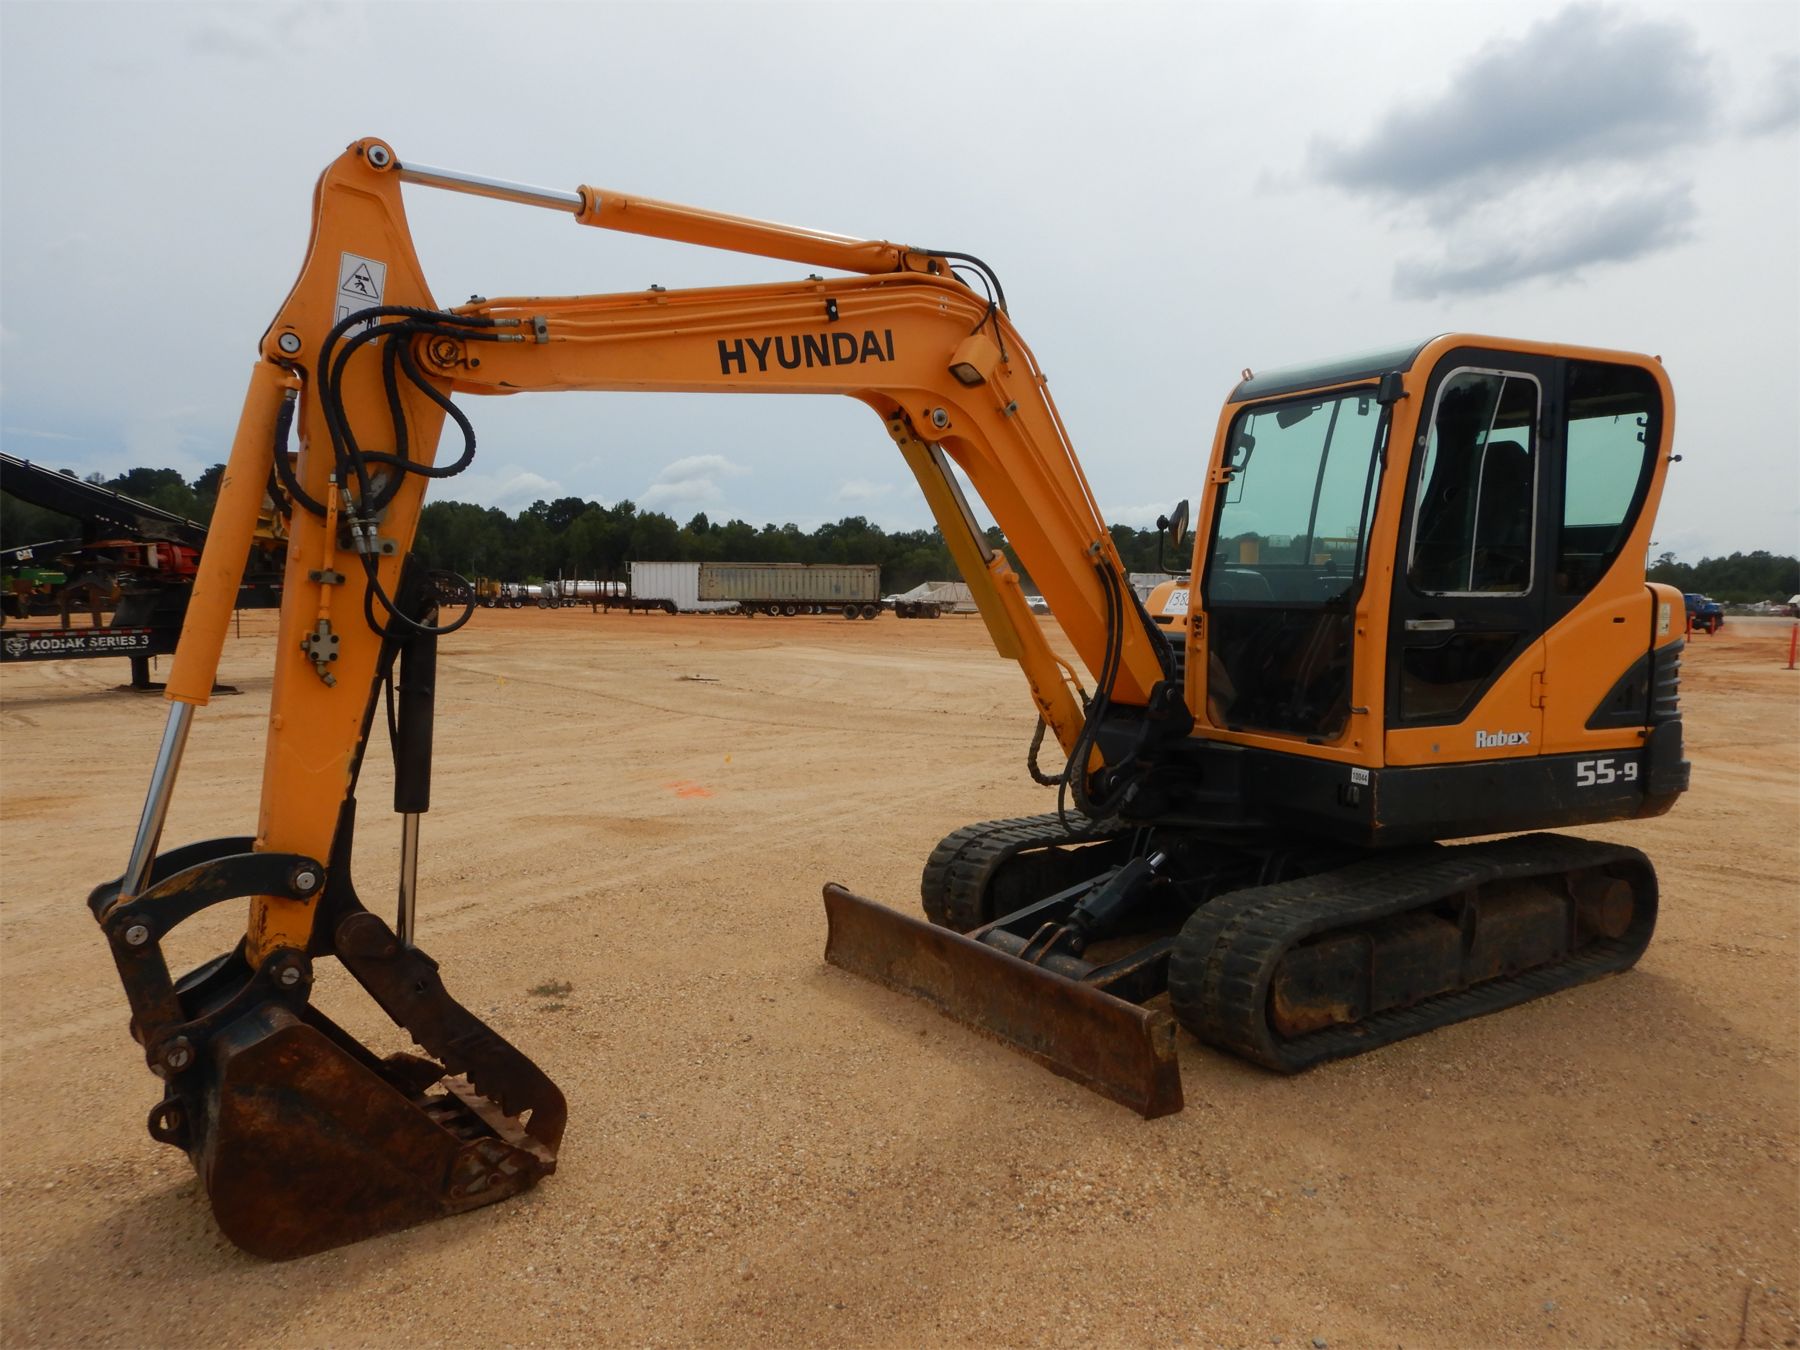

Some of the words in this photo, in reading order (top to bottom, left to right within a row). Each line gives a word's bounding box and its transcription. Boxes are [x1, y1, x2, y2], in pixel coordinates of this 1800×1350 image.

[718, 329, 895, 375] HYUNDAI
[16, 549, 33, 561] CAT
[30, 637, 86, 650] KODIAK
[89, 636, 137, 647] SERIES
[141, 635, 150, 645] 3
[1475, 730, 1531, 748] Robex
[1577, 759, 1638, 787] 55-9
